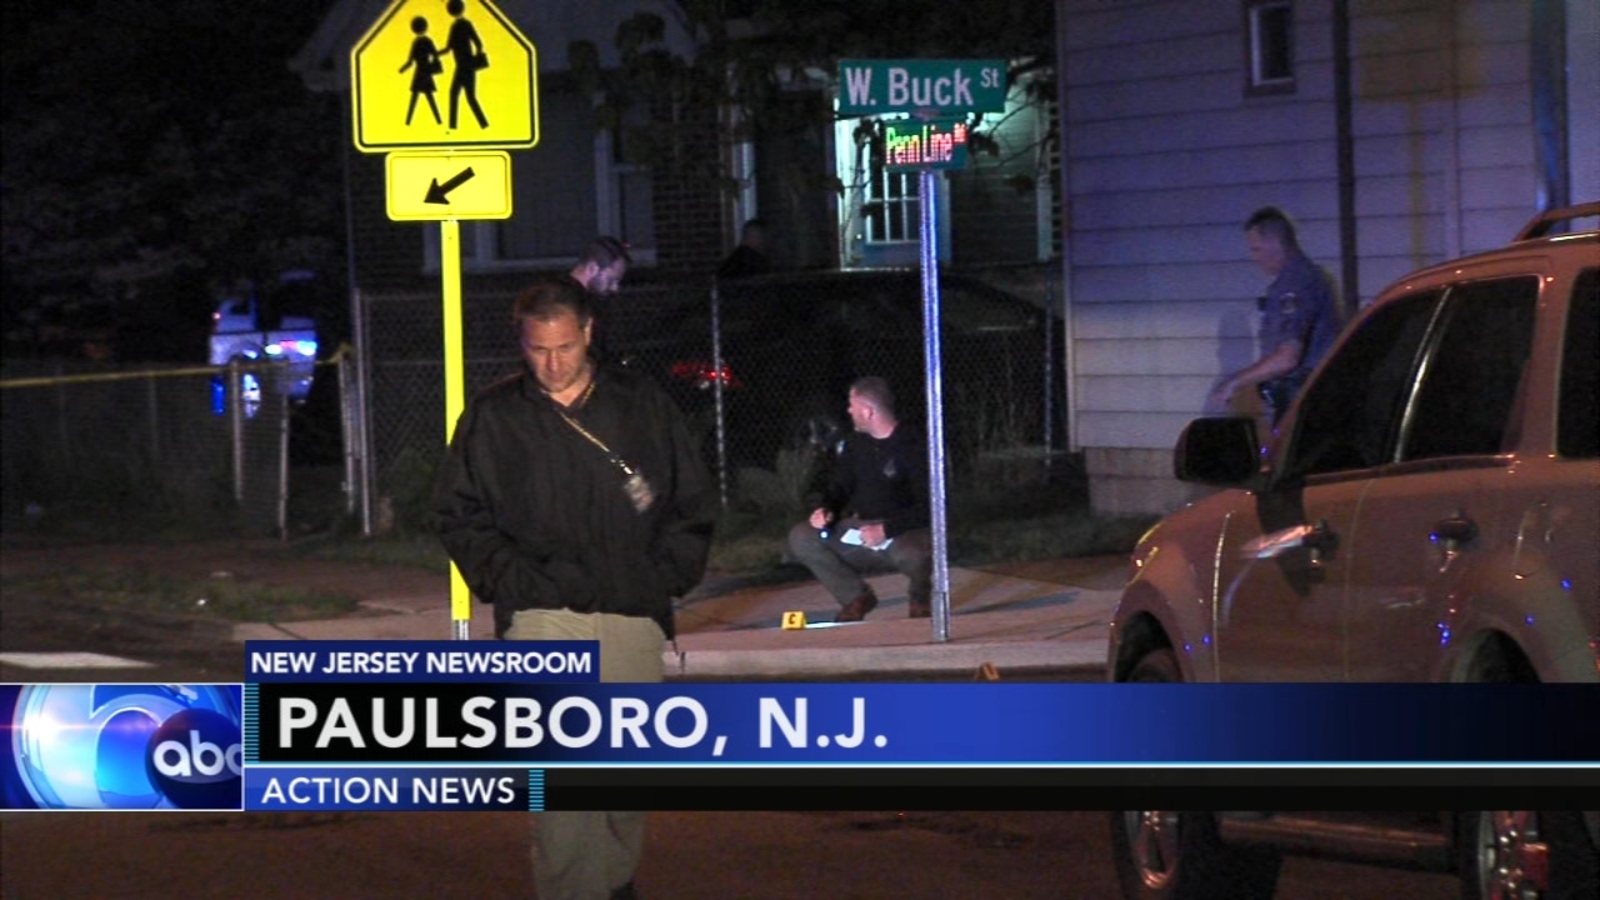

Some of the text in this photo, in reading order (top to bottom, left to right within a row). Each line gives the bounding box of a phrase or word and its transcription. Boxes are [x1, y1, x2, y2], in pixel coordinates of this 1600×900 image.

[845, 67, 999, 106] W. Buck St
[886, 126, 920, 164] Penn
[922, 124, 952, 162] Line
[788, 613, 797, 625] C
